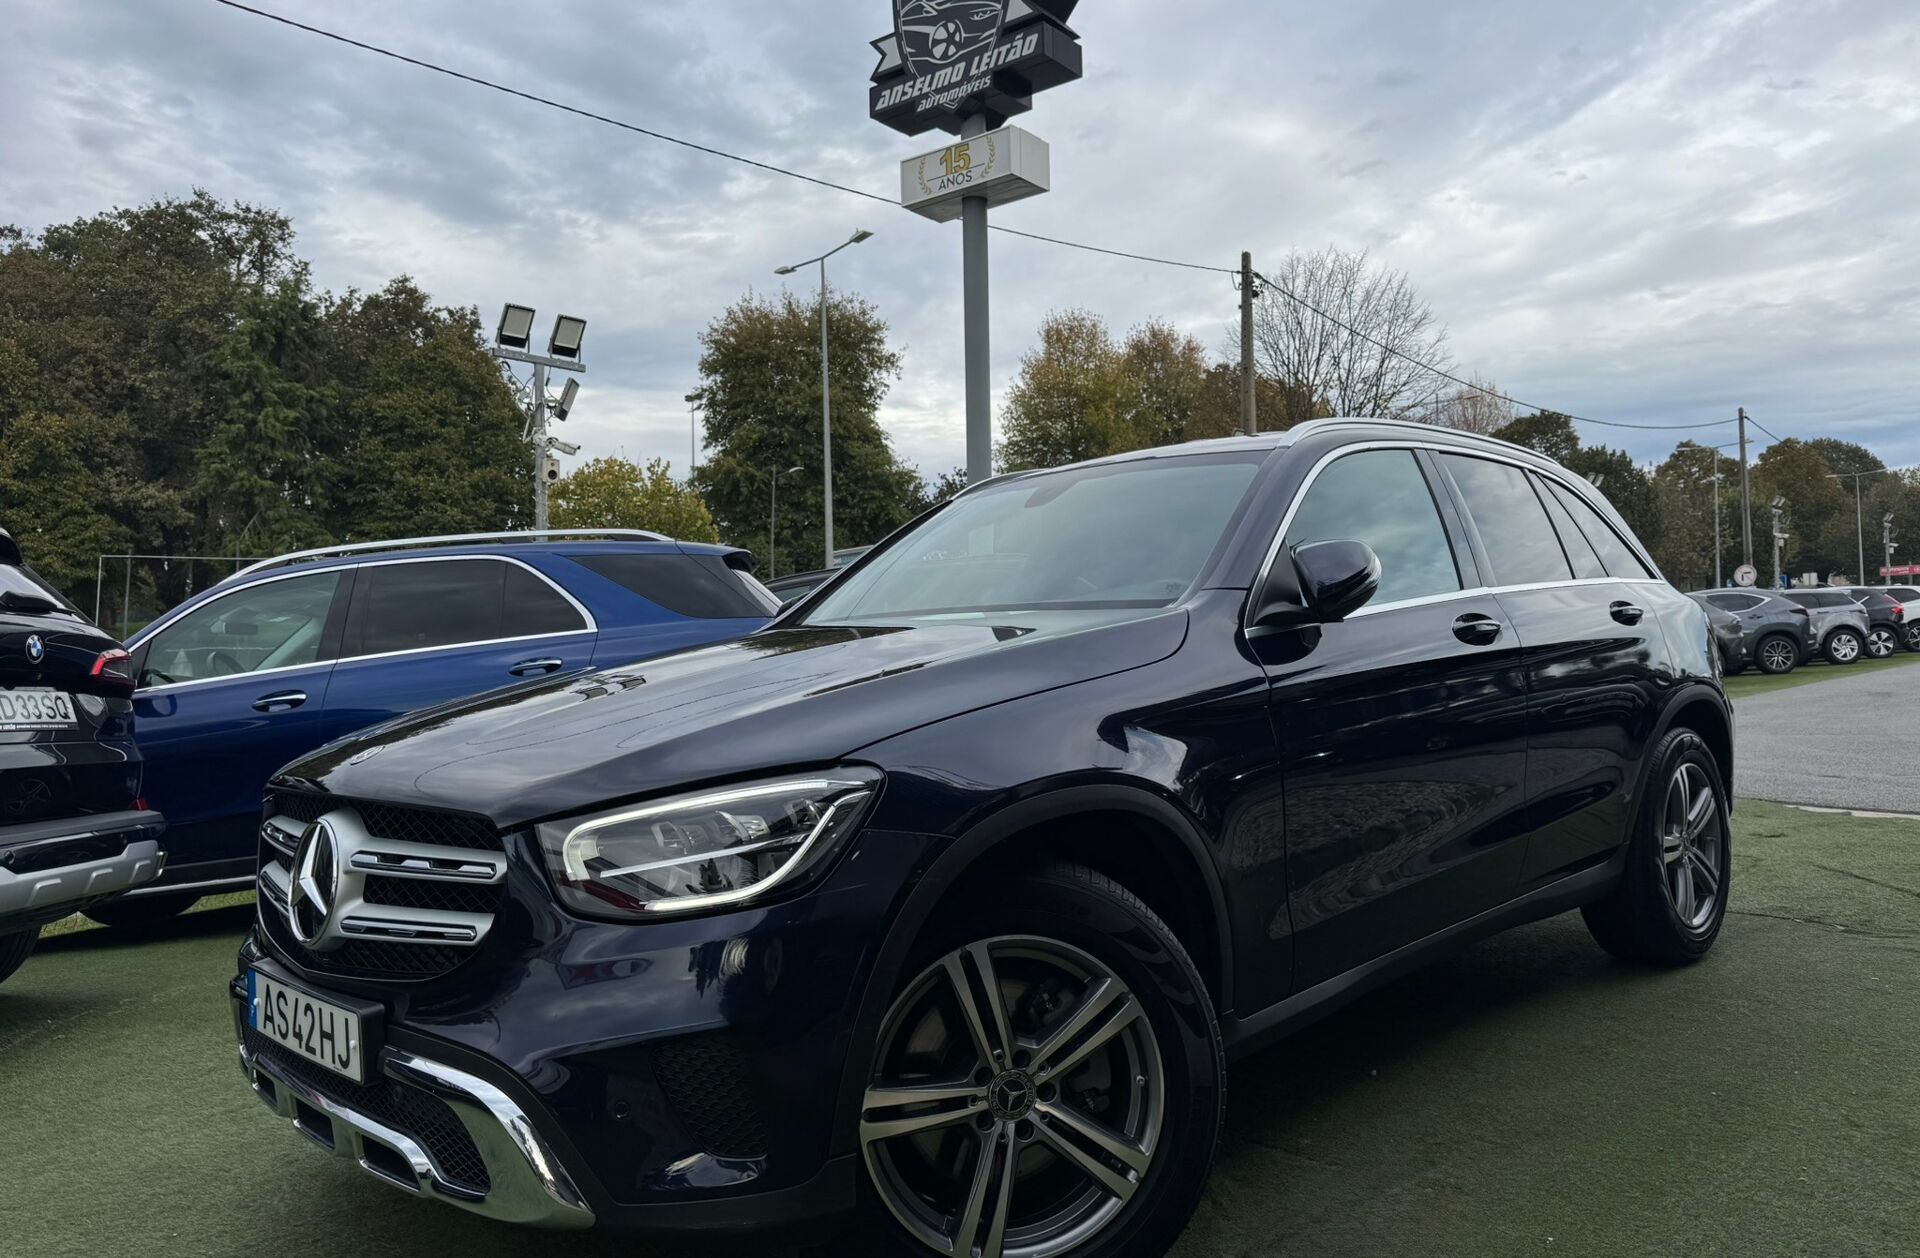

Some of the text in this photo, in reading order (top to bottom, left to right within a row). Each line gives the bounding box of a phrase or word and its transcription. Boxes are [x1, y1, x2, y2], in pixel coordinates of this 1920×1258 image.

[875, 33, 1039, 111] ANSELMO LEITÃO
[940, 143, 971, 175] 15
[938, 170, 972, 191] ANOS
[0, 695, 71, 720] D33SQ
[264, 983, 350, 1069] AS42HJ
